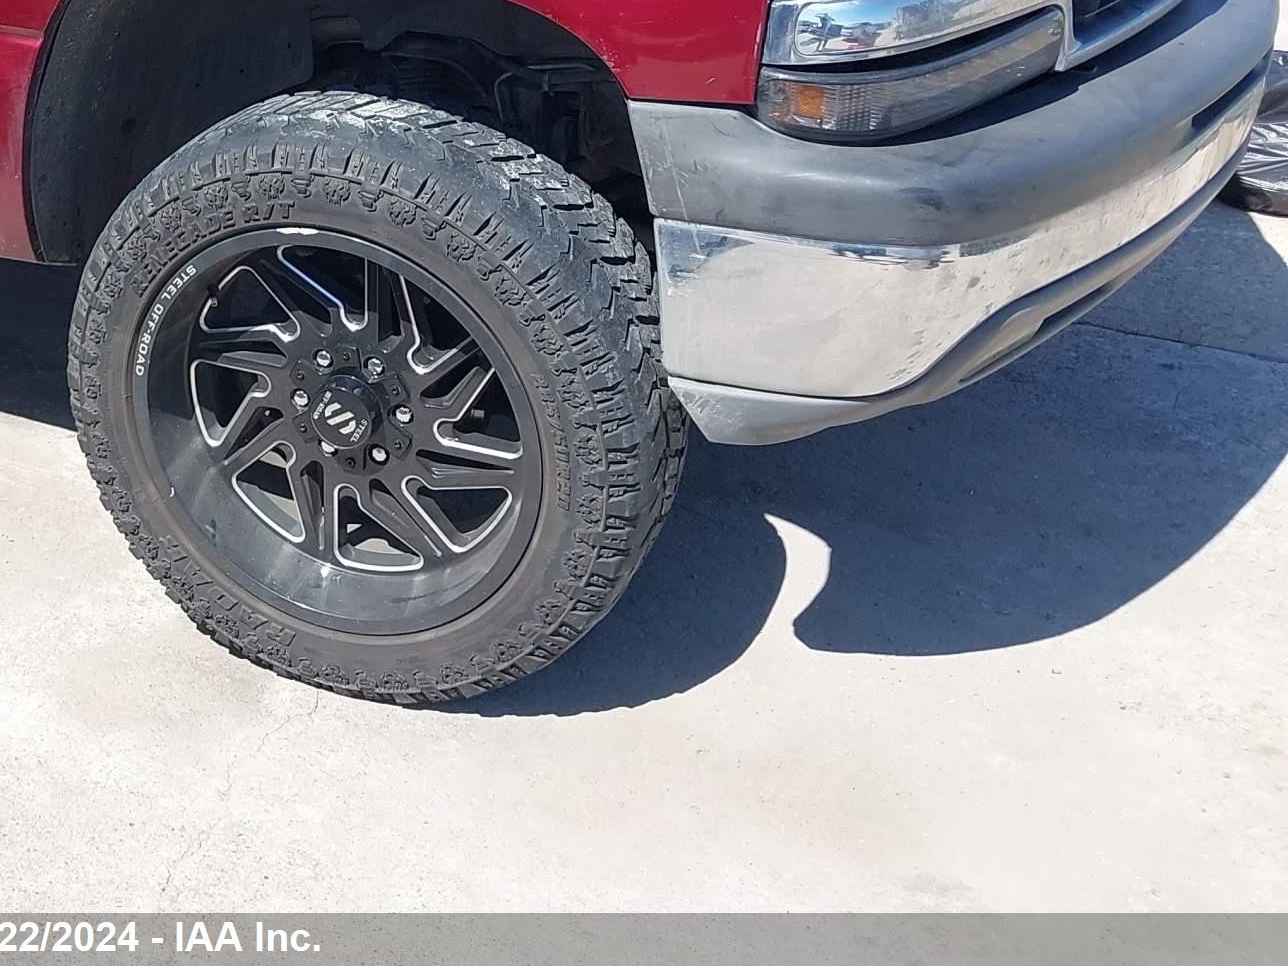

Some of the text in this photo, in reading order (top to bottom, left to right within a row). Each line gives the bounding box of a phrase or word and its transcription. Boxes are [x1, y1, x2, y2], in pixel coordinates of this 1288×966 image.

[132, 200, 296, 298] RENEGADE R/T
[135, 264, 197, 376] STEEL OFF-ROAD
[350, 418, 368, 442] STEEL
[159, 535, 297, 647] RADAR
